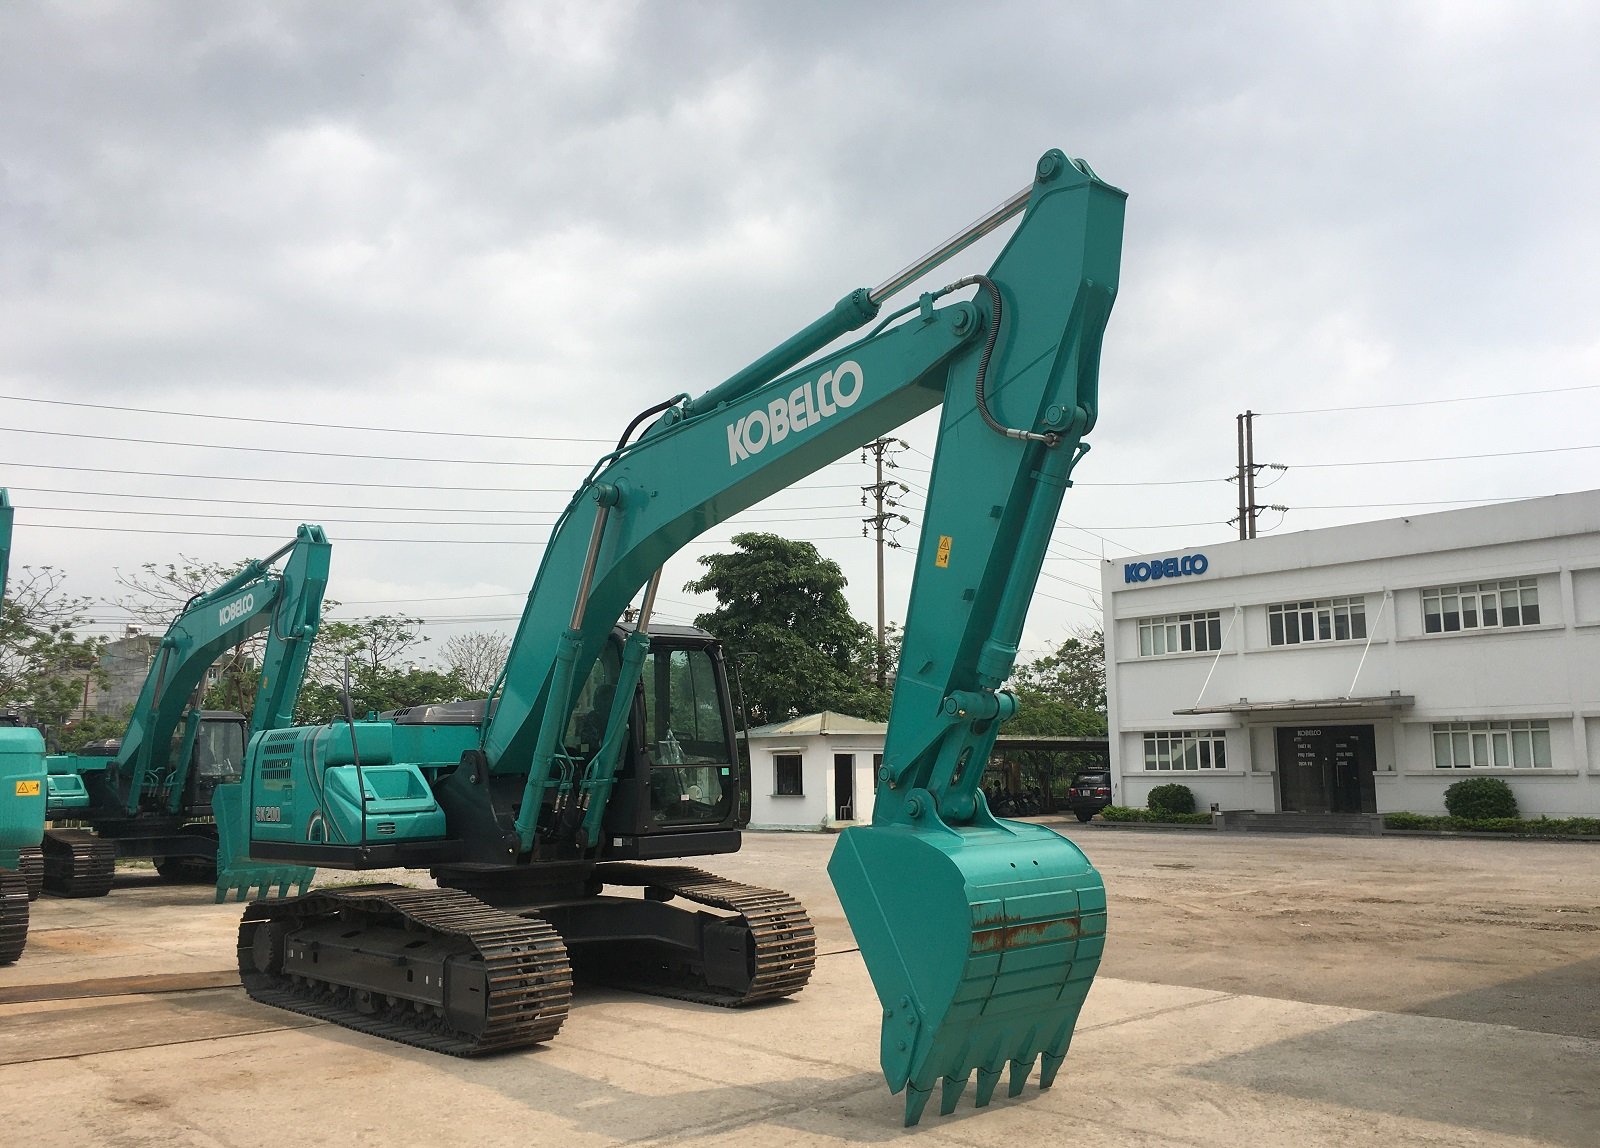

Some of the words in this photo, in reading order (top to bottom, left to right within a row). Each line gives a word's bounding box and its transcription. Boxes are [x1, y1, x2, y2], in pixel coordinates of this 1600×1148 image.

[726, 360, 864, 467] KOBELCO
[1124, 554, 1209, 583] KOBELCO
[219, 593, 254, 627] KOBELCO
[1297, 729, 1322, 737] KOBELCO
[255, 806, 281, 822] SK200
